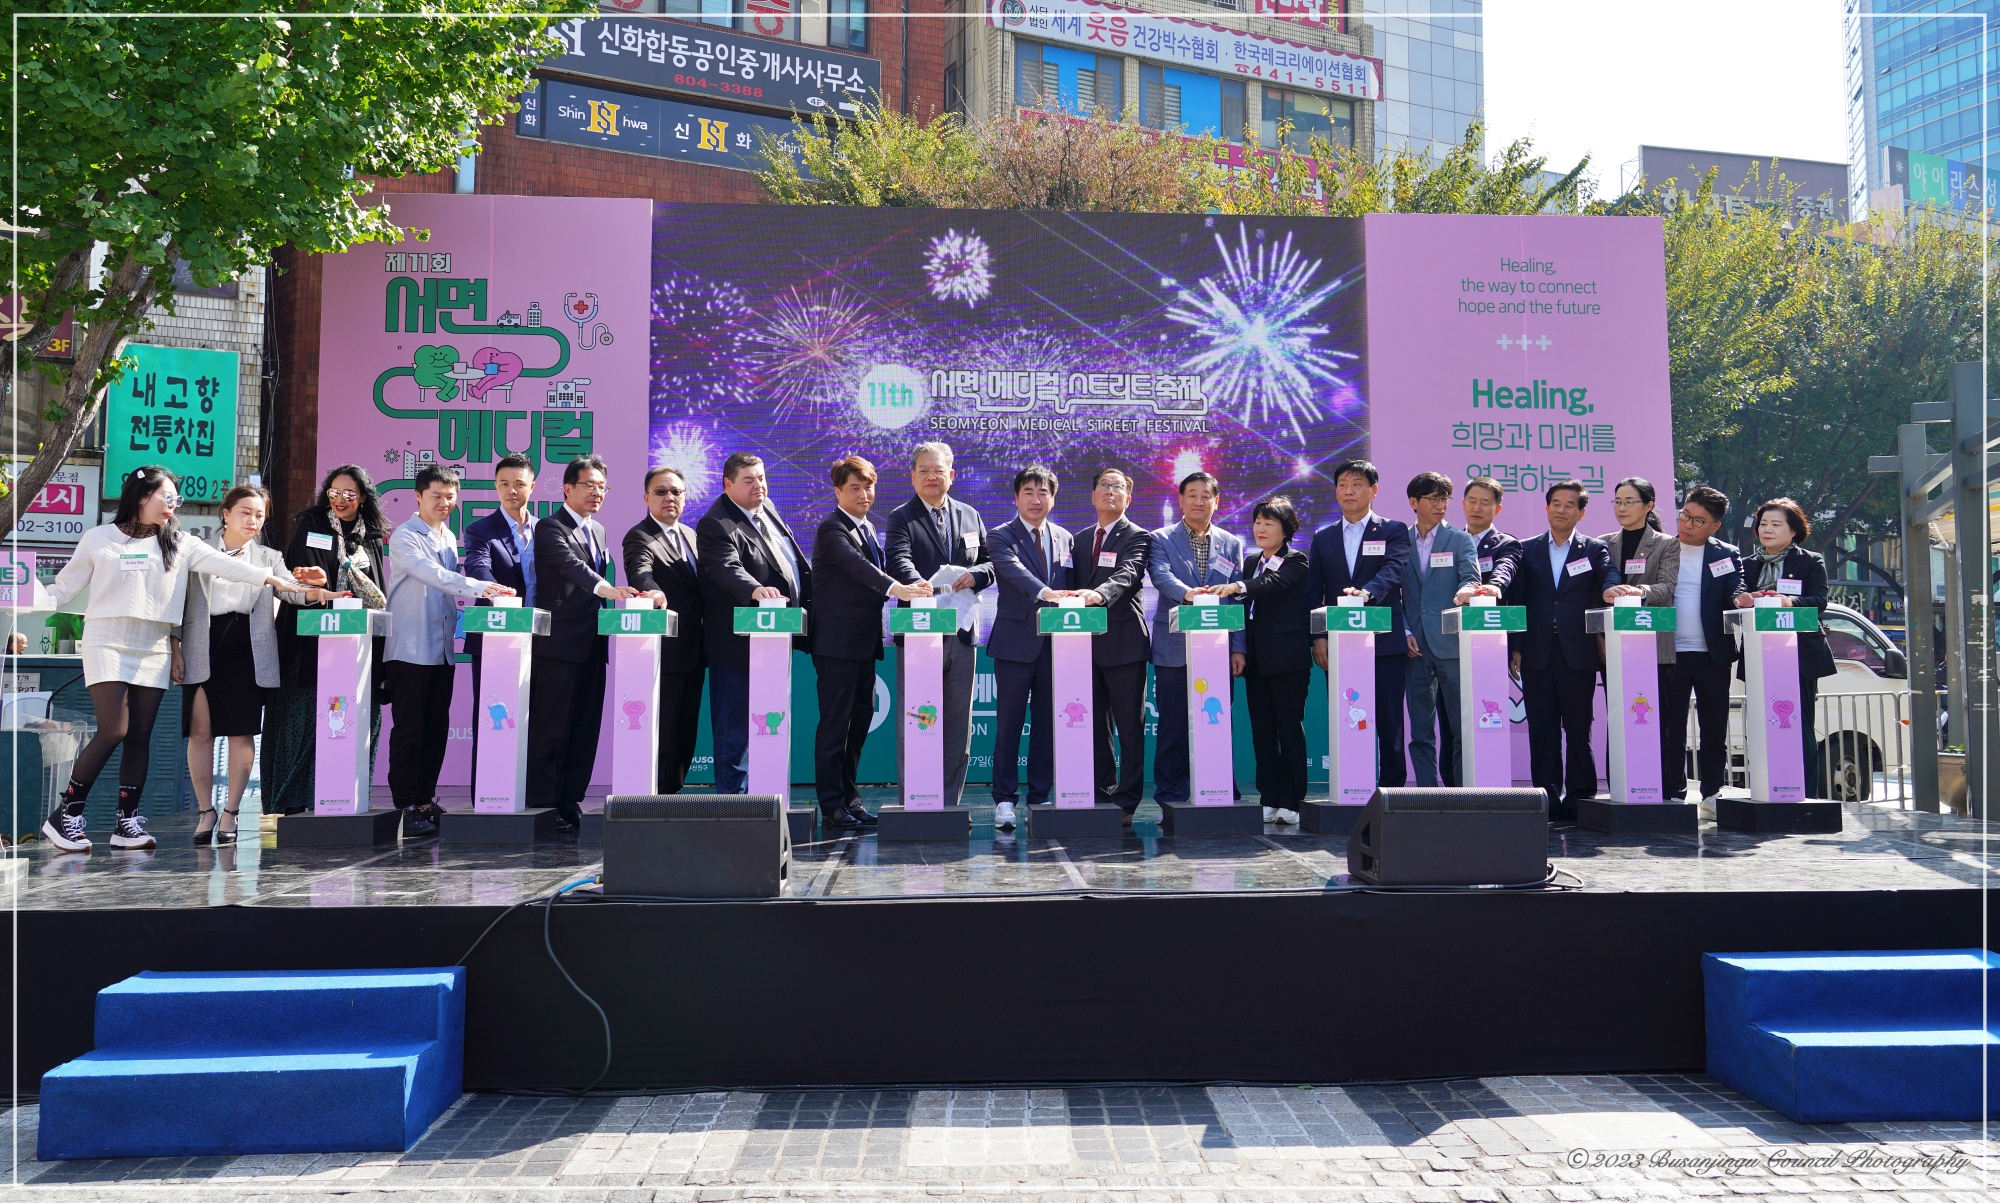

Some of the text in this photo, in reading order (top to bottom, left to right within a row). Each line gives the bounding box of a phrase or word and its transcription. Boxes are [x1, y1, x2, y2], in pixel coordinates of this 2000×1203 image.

[1029, 17, 1048, 29] 법인
[1051, 9, 1366, 84] 세계 웃음 건강박수협회 한국레크리에이션협회
[598, 22, 866, 94] 신화합동공인중개사사무소
[674, 74, 763, 98] 804-3388
[558, 104, 586, 120] Shin
[623, 114, 648, 131] hwa
[674, 123, 690, 140] 신
[736, 132, 752, 149] 화
[385, 252, 451, 273] 제11회
[1500, 258, 1557, 275] Healing,
[1461, 278, 1597, 295] the way to connect
[385, 276, 487, 333] 서면
[1458, 298, 1601, 315] hope and the future
[47, 338, 70, 352] 3F
[930, 369, 976, 398] 서면
[987, 370, 1059, 401] 메디컬
[867, 382, 914, 407] 11th
[1472, 379, 1594, 416] Healing,
[930, 416, 1210, 434] SEOMYEON MEDICAL STREET FESTIVAL
[129, 415, 215, 457] 전통찻집
[438, 409, 593, 464] 메디컬
[1452, 421, 1616, 453] 희망과 미래를
[320, 612, 340, 631] 서
[487, 611, 506, 629] 면
[621, 613, 641, 631] 메
[756, 611, 775, 630] 디
[912, 612, 930, 630] 컬
[1063, 611, 1081, 629] 스
[1201, 609, 1218, 626] 트
[1348, 610, 1366, 628] 리
[1483, 610, 1501, 627] 트
[1635, 610, 1653, 628] 축
[1775, 611, 1794, 629] 제
